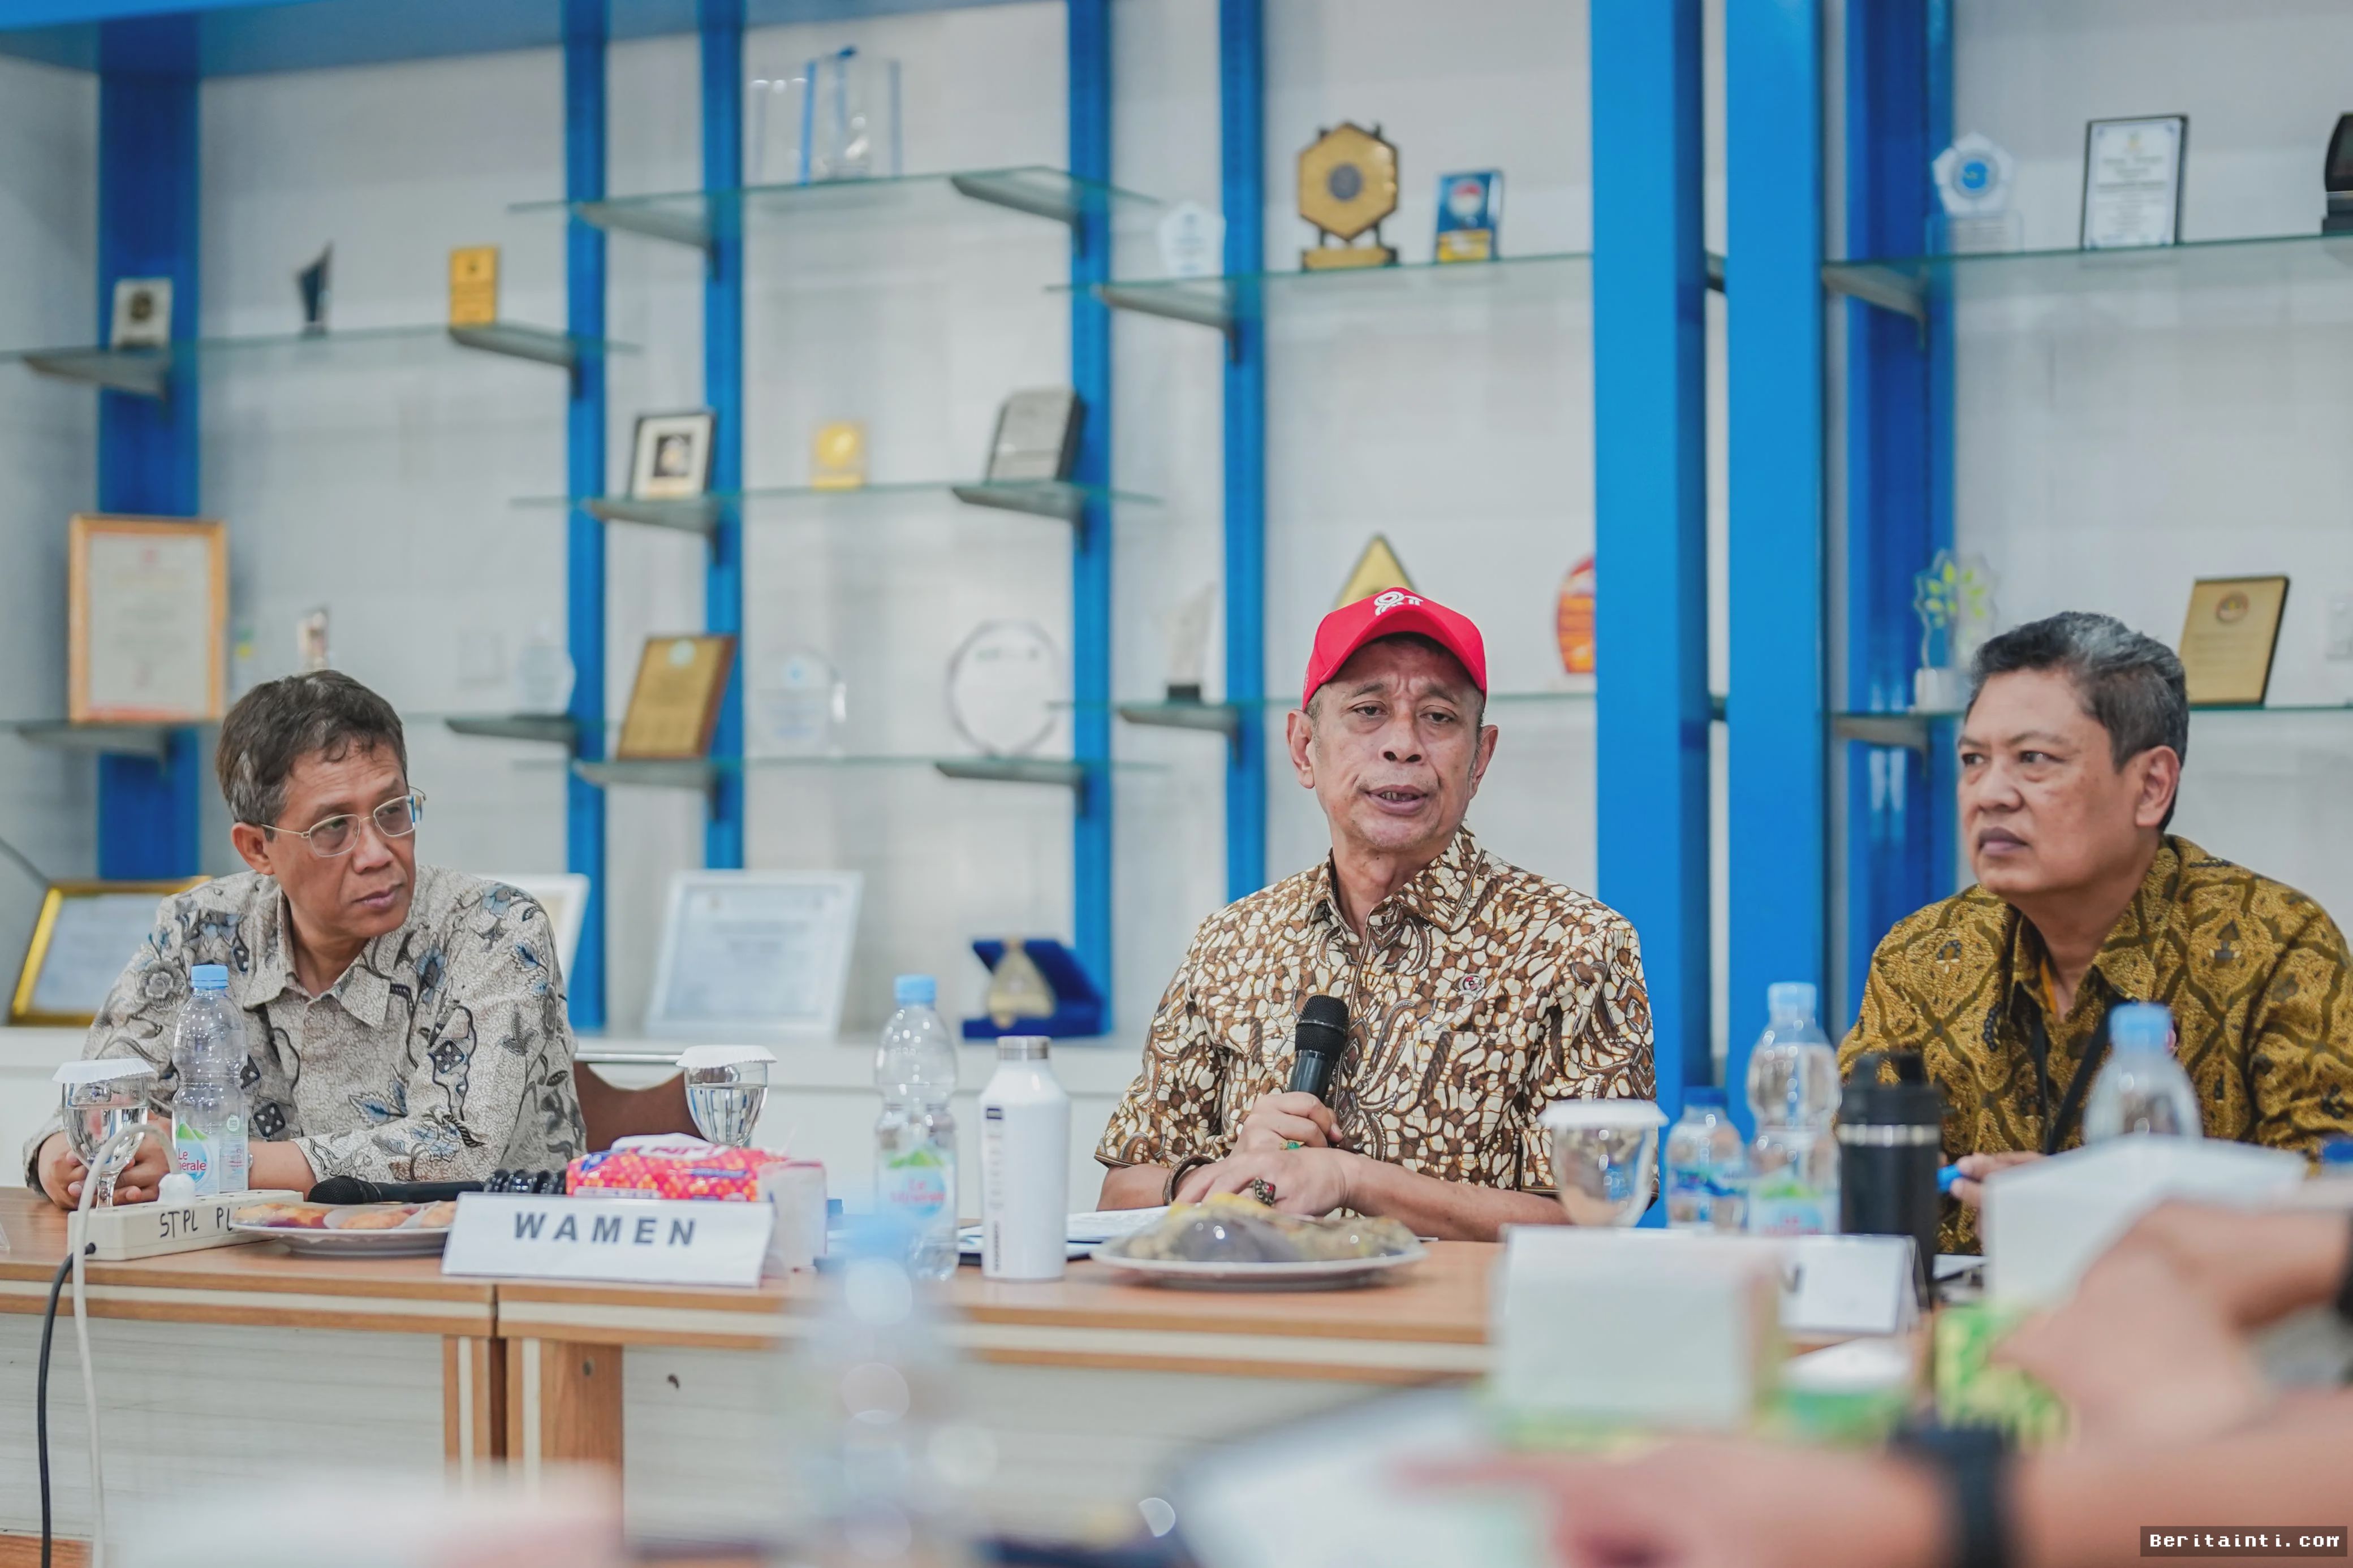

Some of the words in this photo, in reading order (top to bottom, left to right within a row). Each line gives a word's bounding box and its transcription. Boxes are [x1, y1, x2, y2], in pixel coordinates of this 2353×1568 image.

[178, 1147, 188, 1160] Le
[178, 1159, 206, 1171] nerale
[160, 1209, 199, 1238] STPL
[216, 1207, 240, 1232] PL
[515, 1212, 695, 1245] WAMEN
